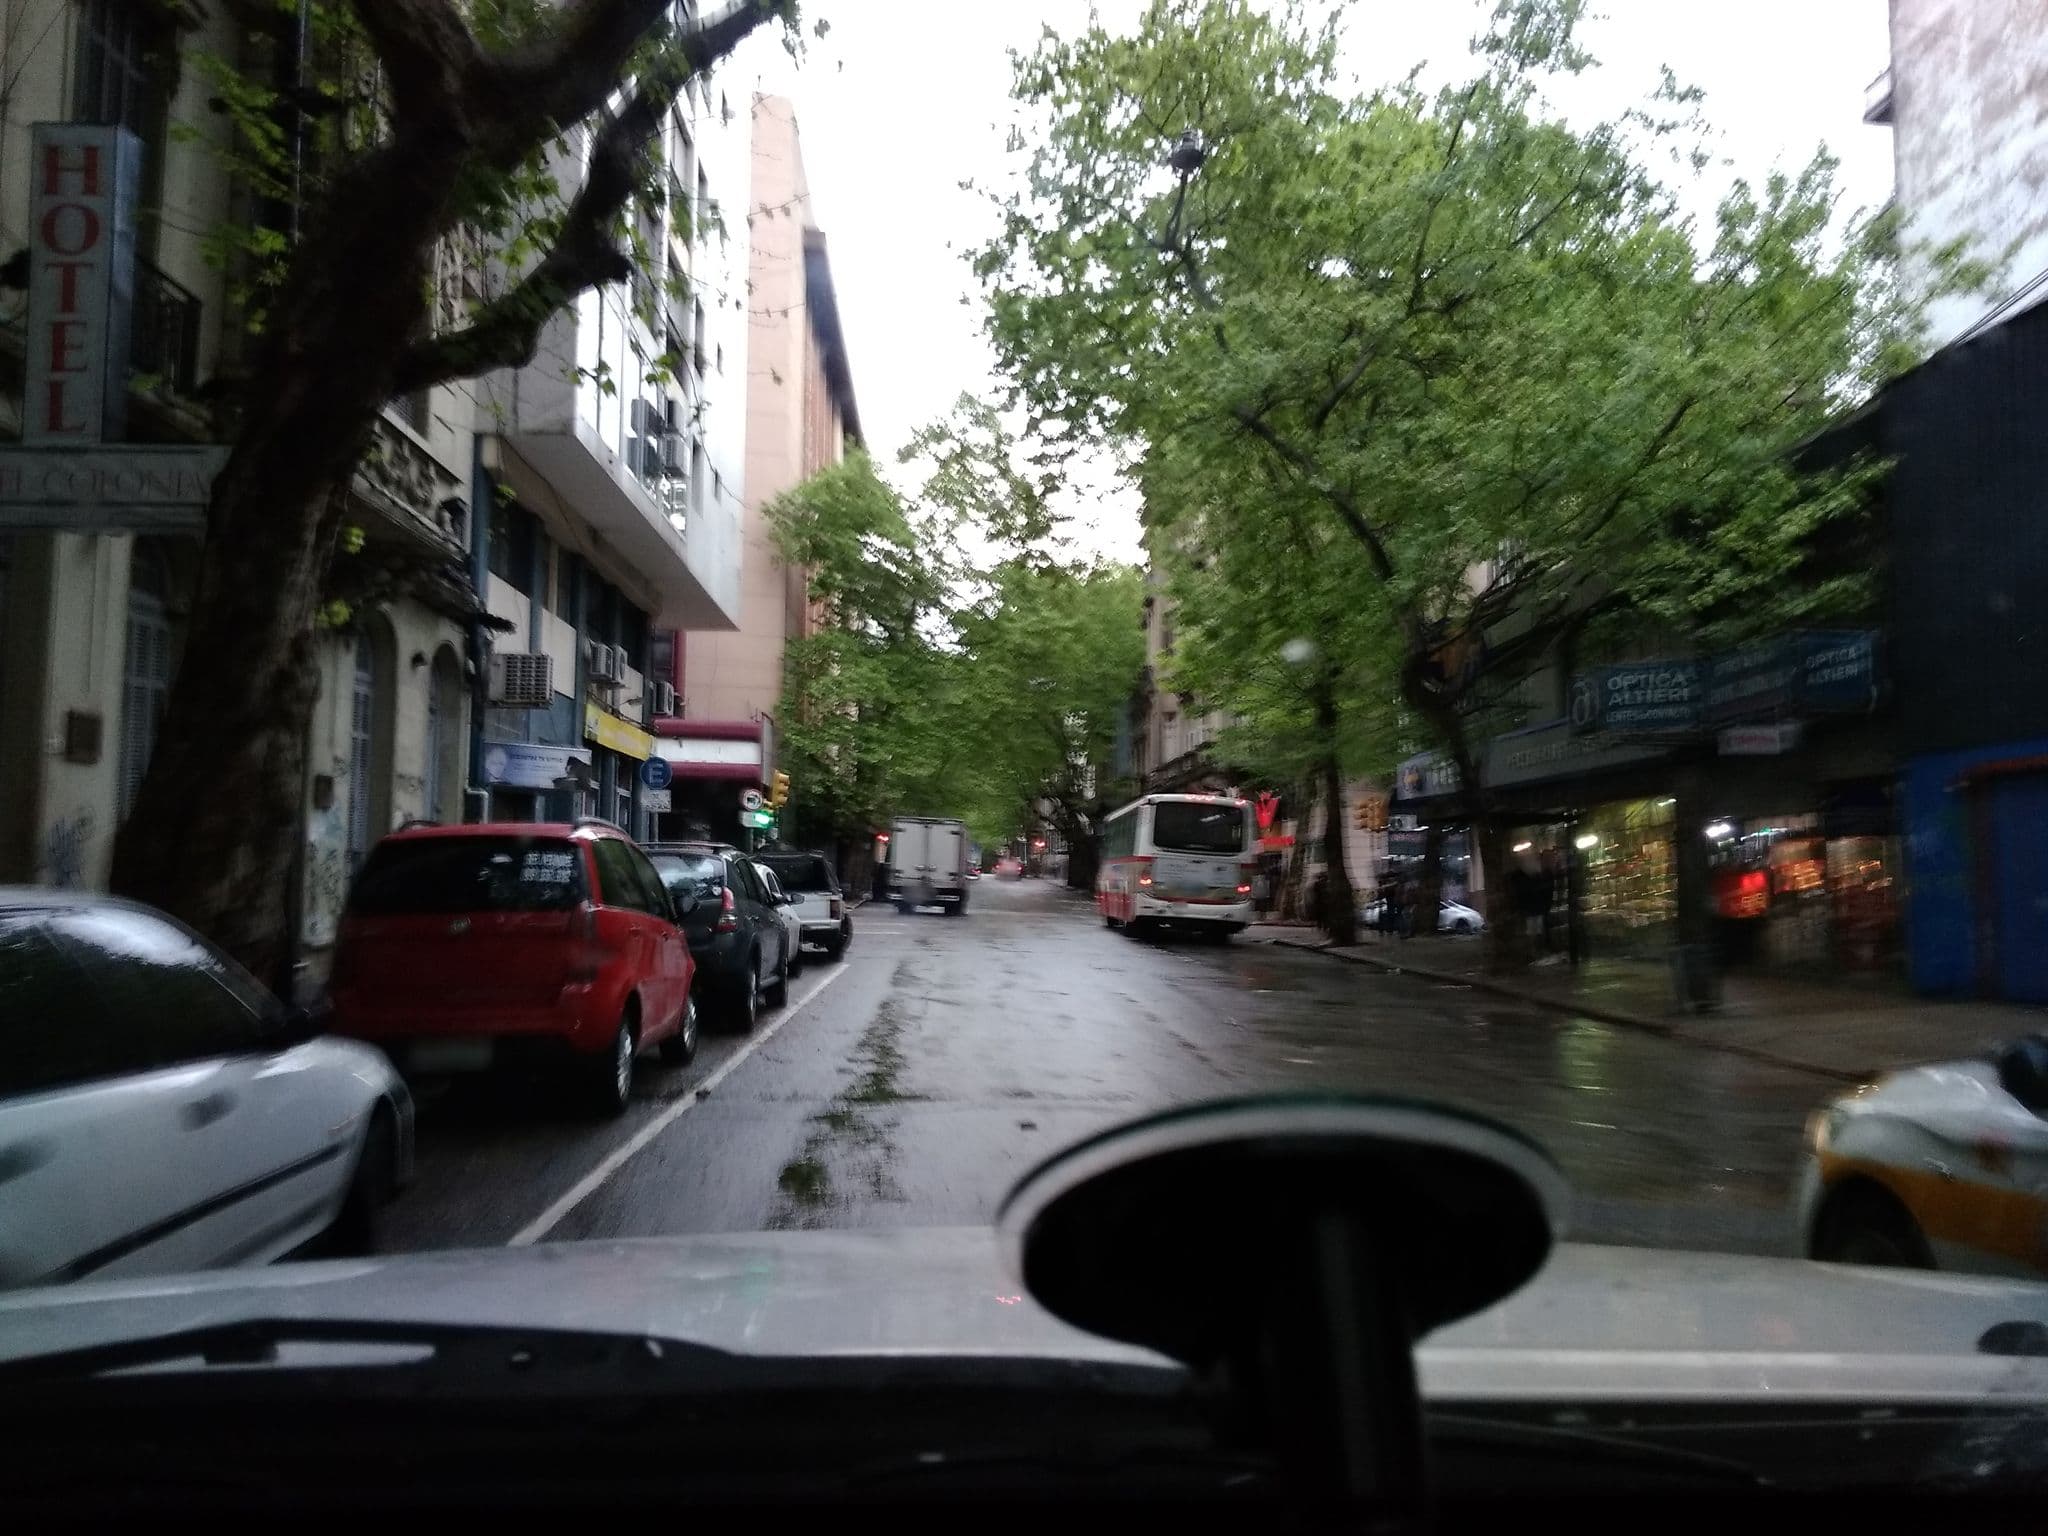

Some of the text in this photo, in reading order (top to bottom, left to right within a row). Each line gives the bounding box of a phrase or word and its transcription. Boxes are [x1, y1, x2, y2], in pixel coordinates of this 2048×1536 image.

[41, 145, 104, 433] HOTEL
[1609, 687, 1689, 706] ALTIERI
[648, 762, 664, 784] E
